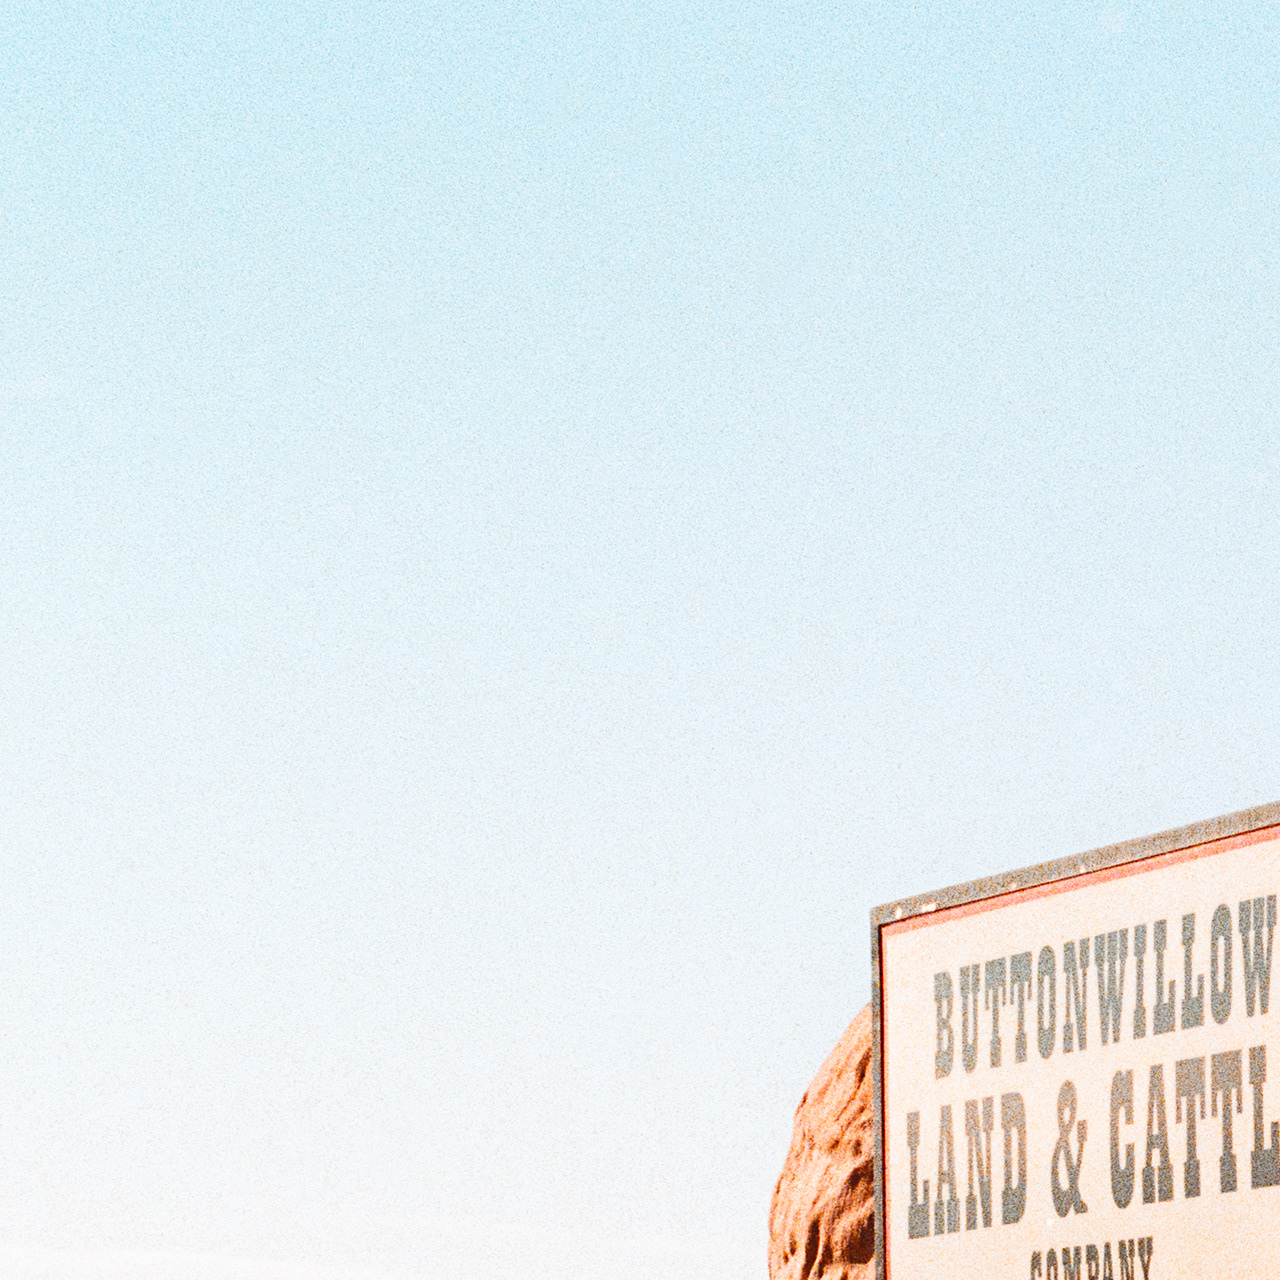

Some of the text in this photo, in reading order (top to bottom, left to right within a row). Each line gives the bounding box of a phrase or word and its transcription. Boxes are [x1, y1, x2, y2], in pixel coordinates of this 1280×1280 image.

[933, 895, 1277, 1080] BUTTONWILLOW
[906, 1091, 1027, 1240] LAND
[1050, 1079, 1088, 1218] &
